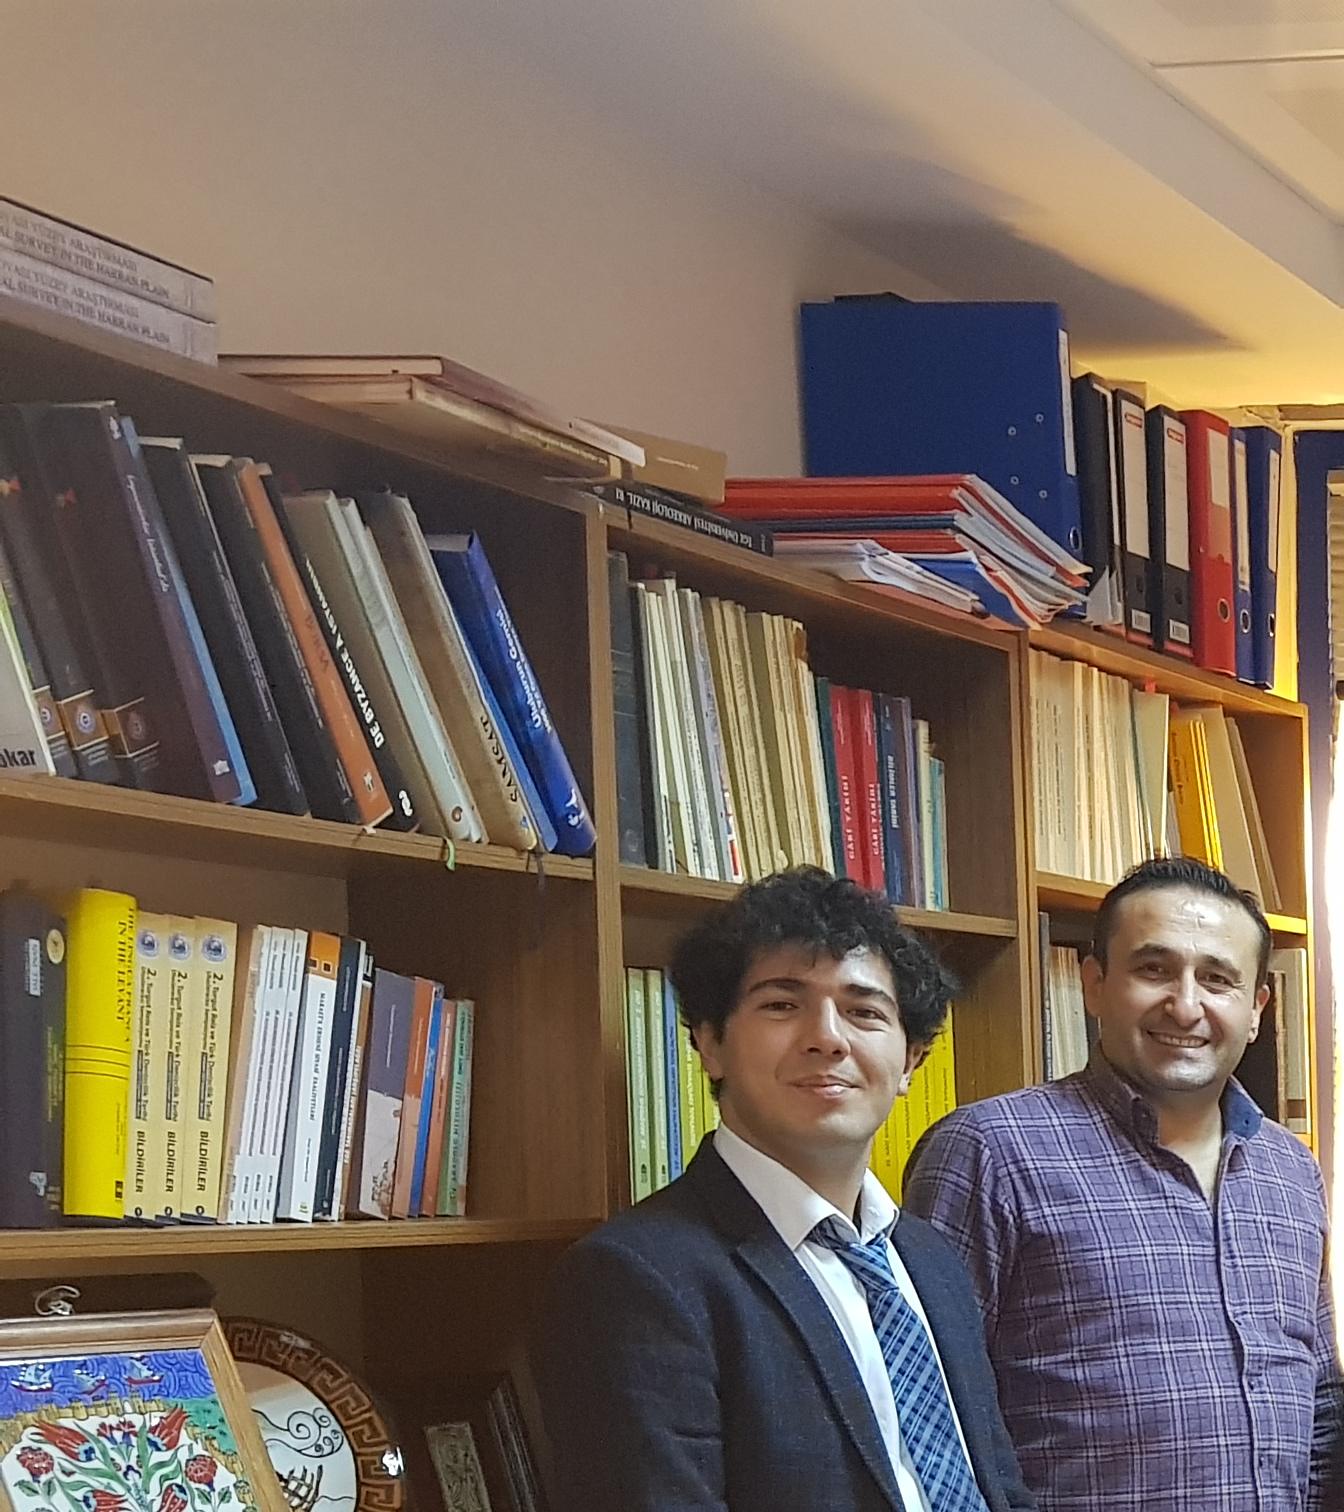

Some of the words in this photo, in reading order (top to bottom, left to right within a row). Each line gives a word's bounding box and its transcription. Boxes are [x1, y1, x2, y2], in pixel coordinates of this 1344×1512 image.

[615, 487, 652, 512] KAZILRI
[651, 501, 693, 526] ARKEOLOJİ
[495, 608, 519, 661] Gemisi
[341, 652, 374, 723] BYZANCE
[515, 660, 542, 729] Uluburun
[369, 722, 386, 749] DE
[480, 713, 519, 804] SAMSAT
[117, 920, 127, 935] IN
[116, 939, 127, 965] THE
[146, 968, 157, 982] 2.
[177, 969, 188, 985] 2.
[212, 972, 224, 986] 2.
[115, 970, 126, 1022] LEVANT
[146, 982, 154, 1010] Turgut
[175, 986, 184, 1012] Turgut
[211, 987, 219, 1012] Turgut
[174, 1013, 182, 1029] Reis
[209, 1013, 218, 1030] Reis
[144, 1029, 151, 1040] ve
[173, 1030, 181, 1041] ve
[209, 1031, 217, 1041] ve
[143, 1041, 151, 1058] Türk
[173, 1042, 181, 1059] Türk
[208, 1042, 216, 1059] Türk
[141, 1060, 150, 1096] Denizcilik
[172, 1060, 181, 1096] Denizcilik
[206, 1060, 215, 1095] Denizcilik
[140, 1098, 148, 1122] Tarihi
[170, 1097, 179, 1122] Tarihi
[204, 1097, 213, 1122] Tarihi
[135, 1131, 145, 1193] BİLDİRİLER
[165, 1131, 175, 1192] BİLDİRİLER
[196, 1131, 209, 1192] BİLDİRİLER
